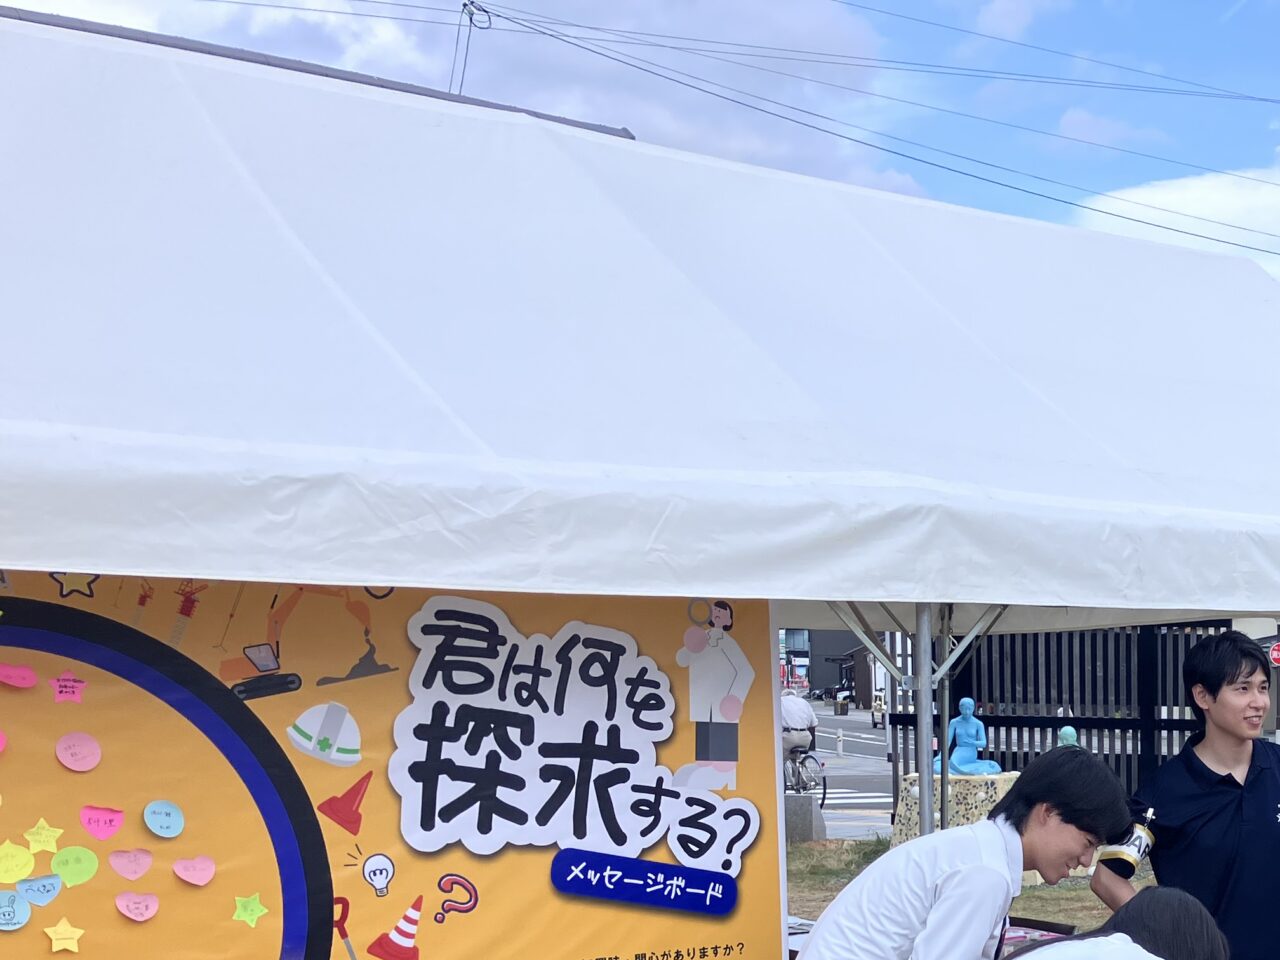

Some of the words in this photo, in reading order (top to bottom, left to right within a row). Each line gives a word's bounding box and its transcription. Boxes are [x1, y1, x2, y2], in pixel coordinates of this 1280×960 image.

[421, 609, 666, 731] 君は何を
[408, 700, 751, 871] 探求する？
[566, 861, 723, 905] メッセージボード
